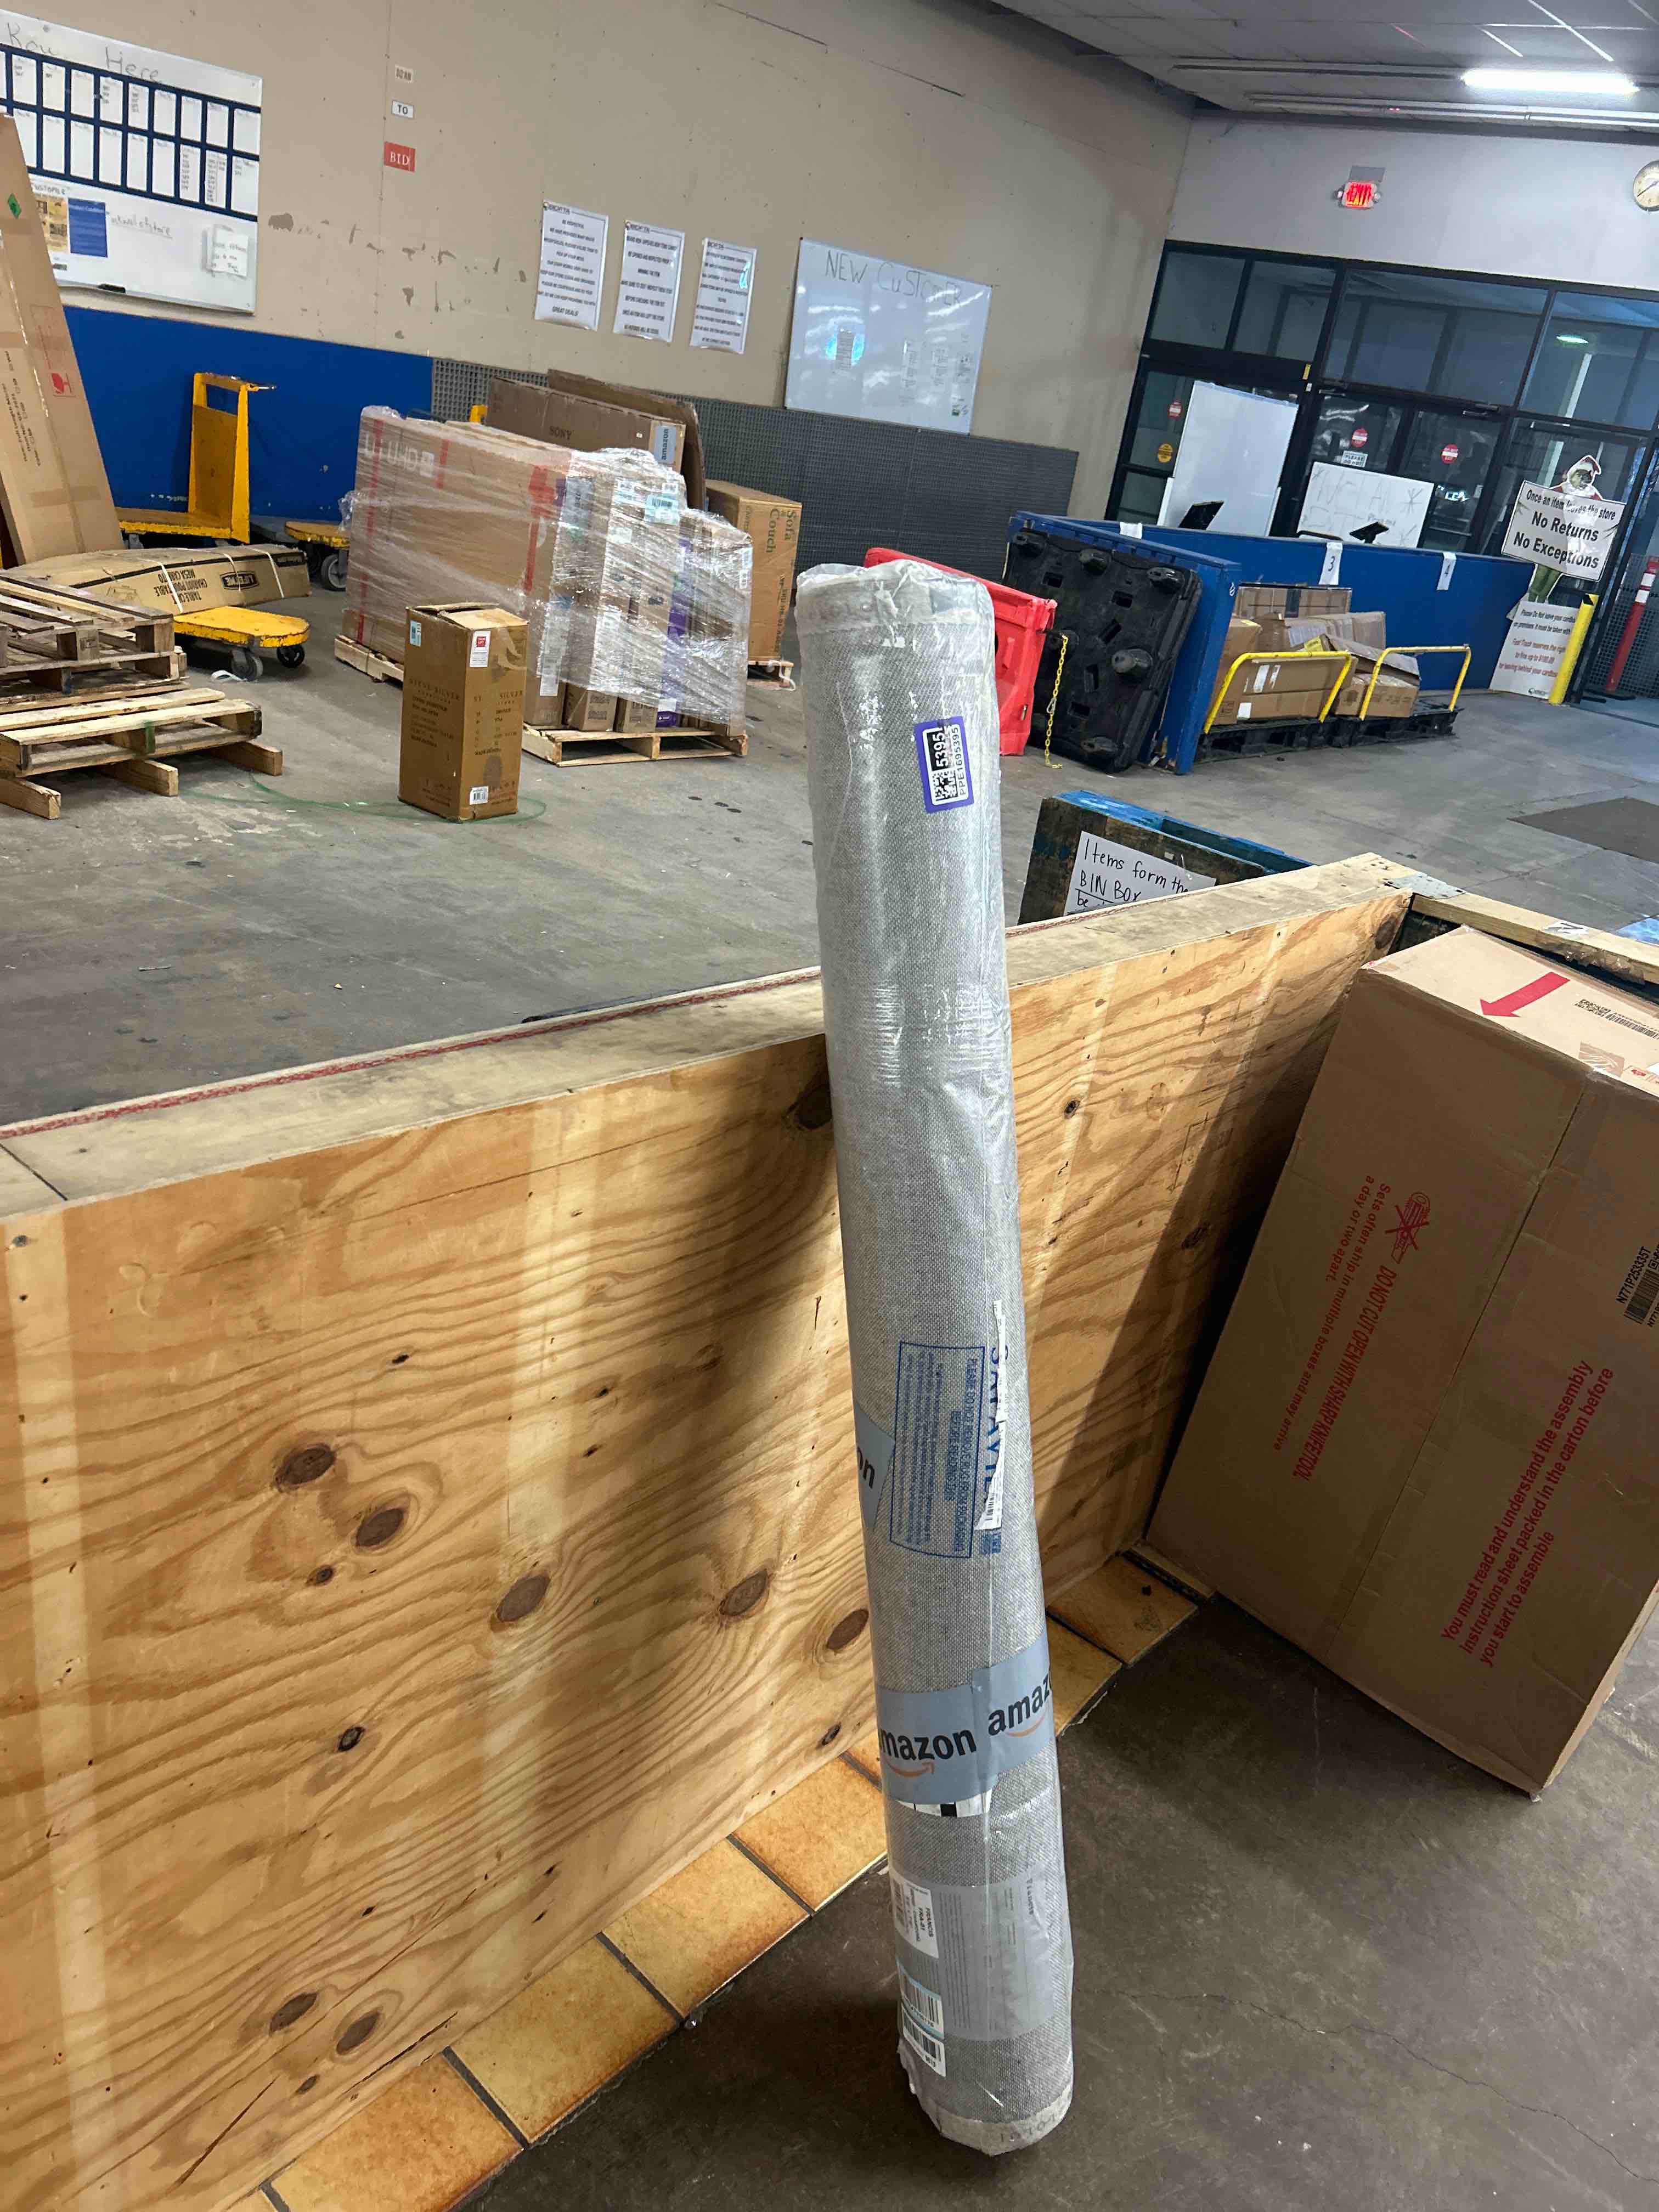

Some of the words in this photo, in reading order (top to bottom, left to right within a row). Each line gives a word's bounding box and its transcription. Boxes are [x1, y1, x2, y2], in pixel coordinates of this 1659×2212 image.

[398, 104, 408, 114] TO
[390, 151, 409, 165] BID
[825, 250, 868, 284] NEW
[1527, 489, 1542, 503] Once
[1543, 496, 1550, 505] an
[1551, 496, 1565, 509] item
[1599, 507, 1616, 520] store
[766, 509, 780, 553] Couch
[785, 510, 796, 540] Sofa
[1532, 511, 1548, 528] No
[1550, 517, 1599, 541] Returns
[1328, 556, 1335, 571] 3
[1513, 531, 1530, 549] No
[1533, 538, 1599, 569] Exceptions
[1444, 565, 1451, 576] 4
[932, 732, 949, 768] 5395
[951, 727, 966, 795] PPE1695395
[1080, 870, 1107, 896] BIN
[1132, 861, 1166, 888] form
[1077, 890, 1088, 907] be
[1355, 1183, 1372, 1209] day
[1372, 1183, 1390, 1212] Sets
[1350, 1210, 1361, 1224] or
[1358, 1212, 1378, 1245] often
[1340, 1225, 1355, 1248] two
[1346, 1245, 1364, 1274] ship
[1342, 1274, 1352, 1286] in
[1366, 1284, 1388, 1309] NOT
[1319, 1287, 1347, 1336] multiple
[1356, 1306, 1378, 1332] CUT
[1307, 1336, 1327, 1370] boxes
[1344, 1329, 1369, 1362] OPEN
[1297, 1370, 1312, 1393] and
[1547, 1359, 1594, 1430] assembly
[1285, 1392, 1301, 1417] may
[1272, 1417, 1293, 1453] arrive
[1538, 1428, 1557, 1452] the
[1497, 1547, 1522, 1584] sheet
[1514, 1499, 1548, 1549] packed
[1539, 1483, 1553, 1498] in
[1547, 1460, 1565, 1484] the
[1559, 1415, 1589, 1461] carton
[1581, 1366, 1614, 1415] before
[1500, 1452, 1547, 1528] understand
[1487, 1527, 1508, 1554] and
[1472, 1553, 1495, 1583] read
[1515, 1530, 1555, 1594] assemble
[1457, 1583, 1481, 1616] must
[1509, 1594, 1522, 1608] to
[1442, 1615, 1464, 1641] You
[1492, 1606, 1516, 1639] start
[1481, 1639, 1502, 1666] you
[879, 1729, 977, 1760] mazon
[988, 1673, 1050, 1736] amaz
